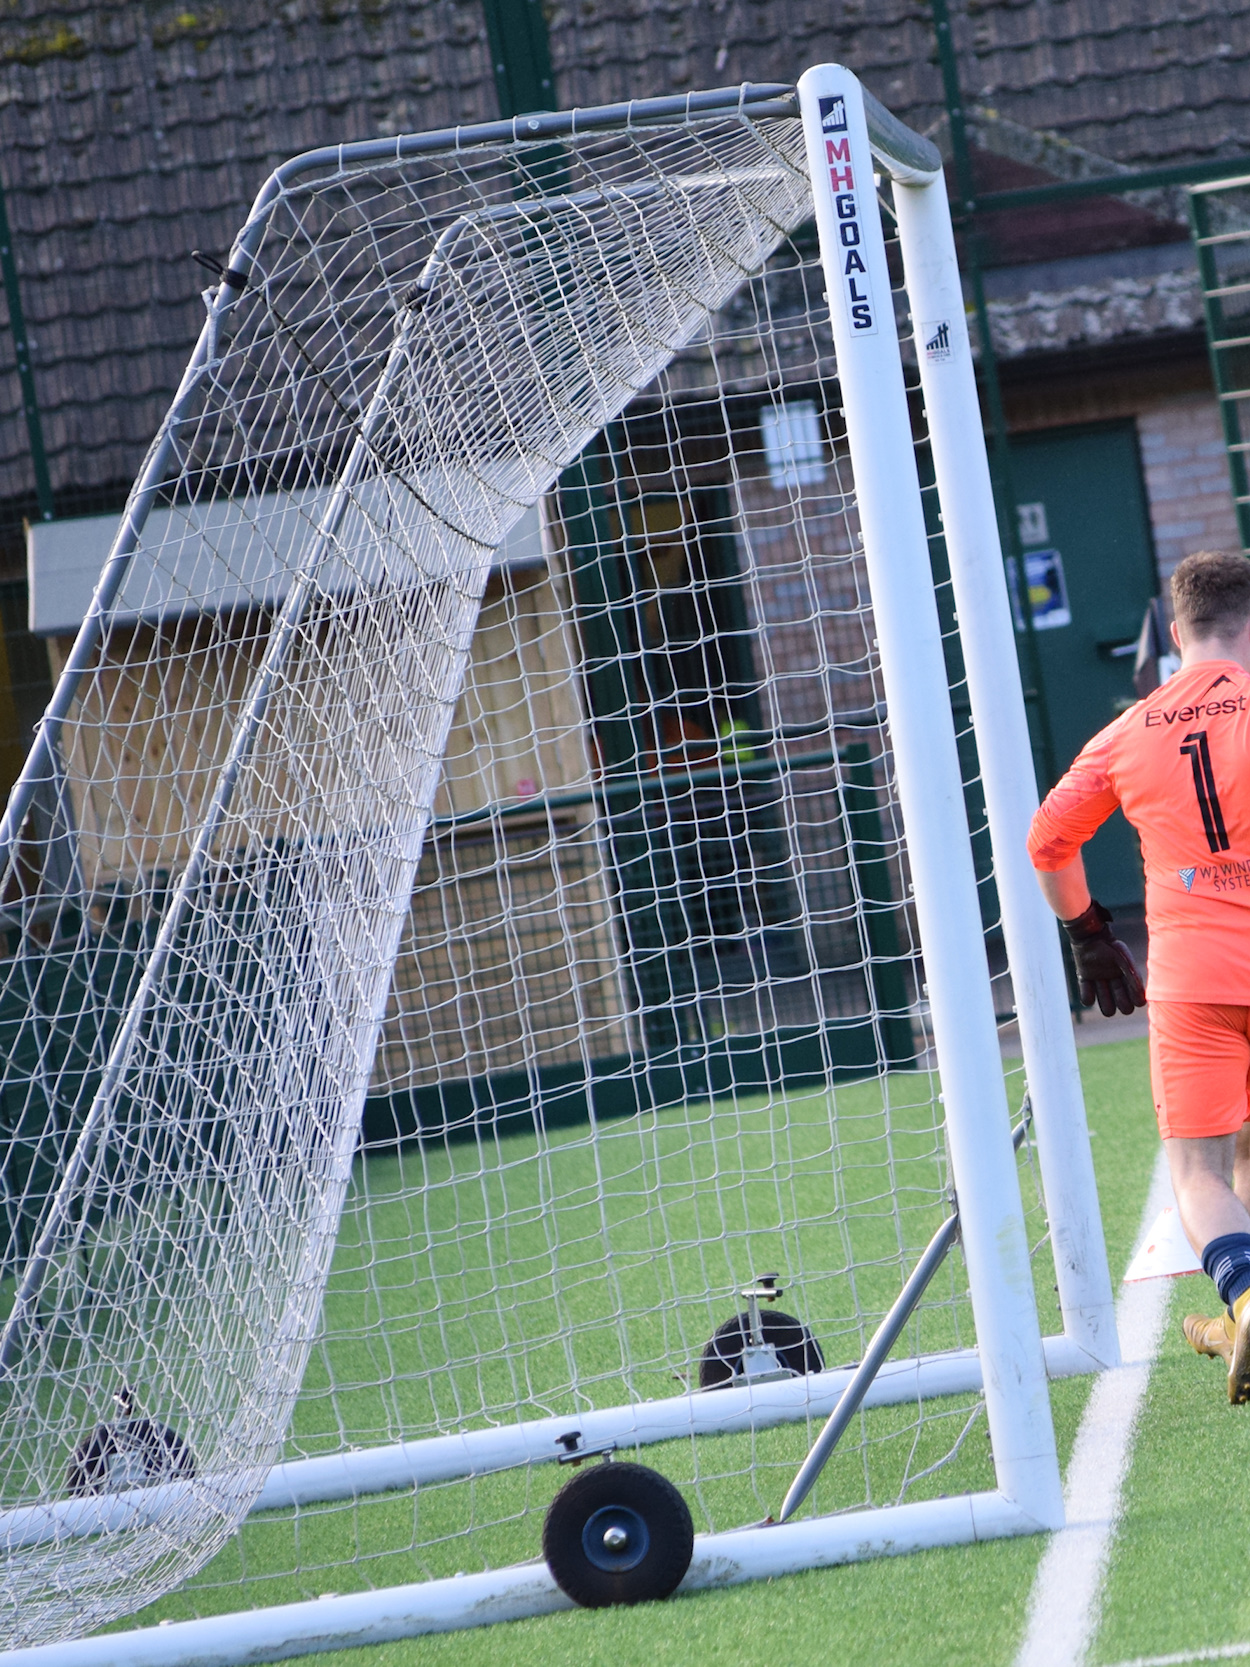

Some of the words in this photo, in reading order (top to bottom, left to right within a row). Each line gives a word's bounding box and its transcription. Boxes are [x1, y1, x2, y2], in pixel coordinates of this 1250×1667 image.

[825, 138, 872, 329] MHGOALS
[1145, 694, 1247, 727] Everest
[1179, 731, 1231, 854] 1
[1200, 865, 1220, 880] W2
